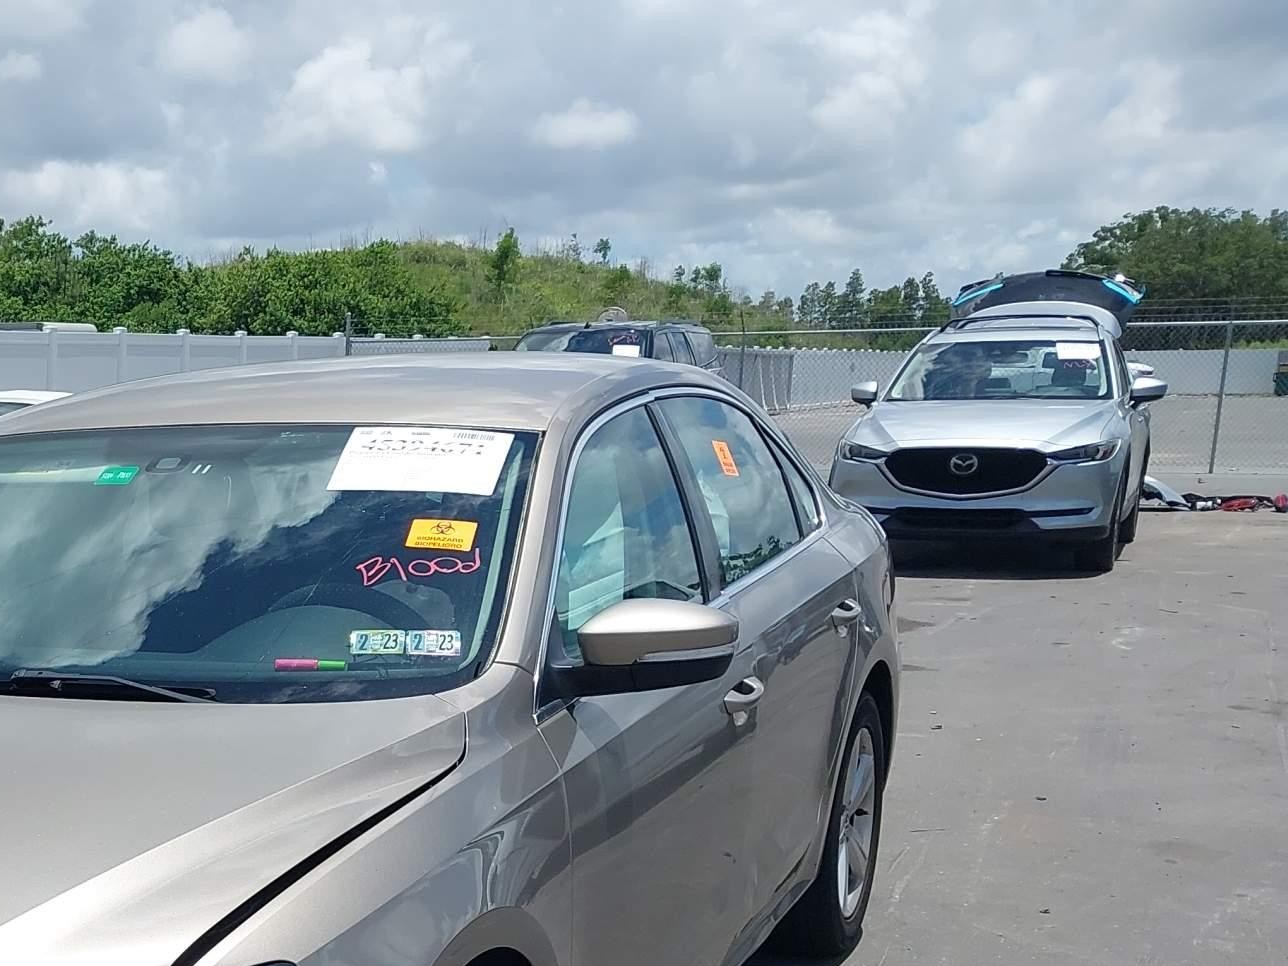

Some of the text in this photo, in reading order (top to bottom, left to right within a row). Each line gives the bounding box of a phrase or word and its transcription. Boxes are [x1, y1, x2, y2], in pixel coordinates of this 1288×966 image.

[355, 548, 481, 586] Blood
[359, 633, 369, 651] 2
[383, 633, 400, 650] 23
[414, 633, 423, 651] 2
[439, 634, 454, 651] 23
